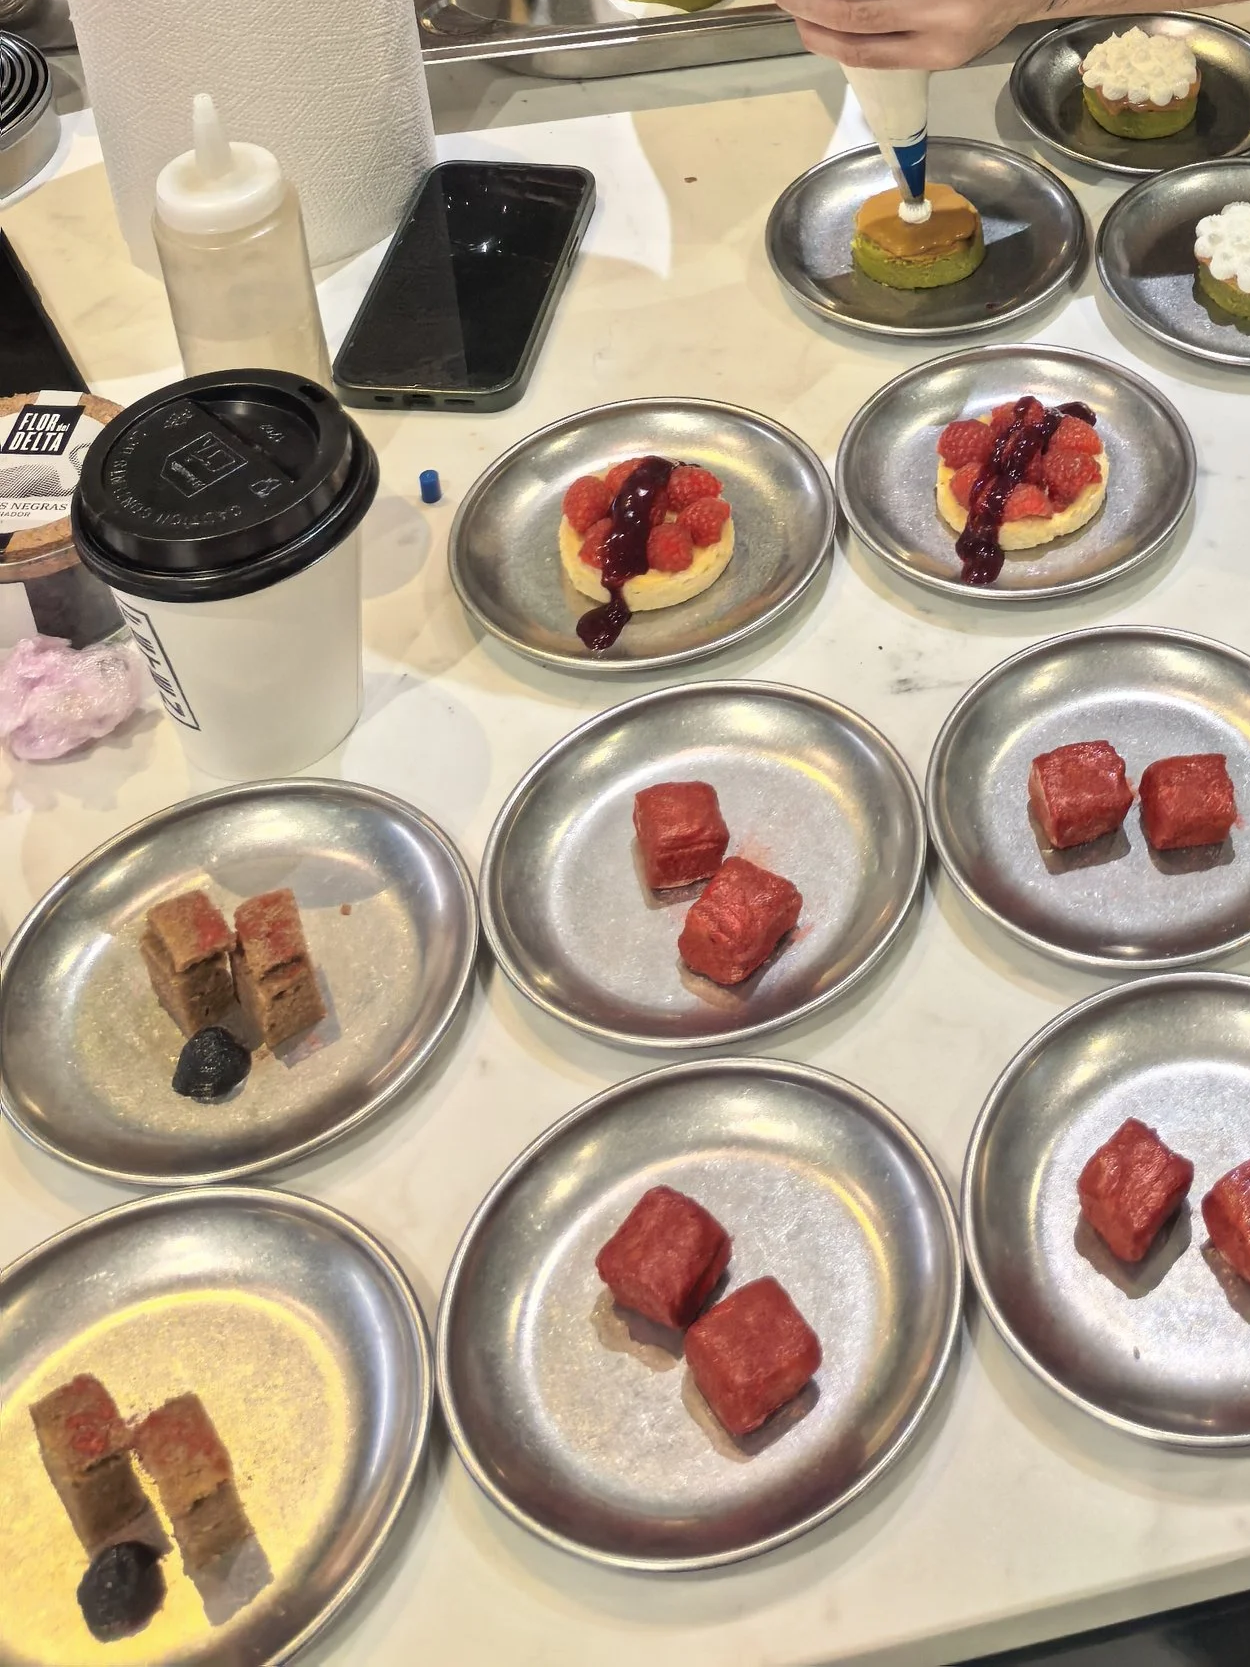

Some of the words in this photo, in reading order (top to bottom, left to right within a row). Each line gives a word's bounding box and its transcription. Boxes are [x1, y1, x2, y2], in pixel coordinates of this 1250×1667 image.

[18, 412, 61, 432] FLOR
[8, 431, 65, 452] DELTA
[10, 502, 68, 511] NEGRAS
